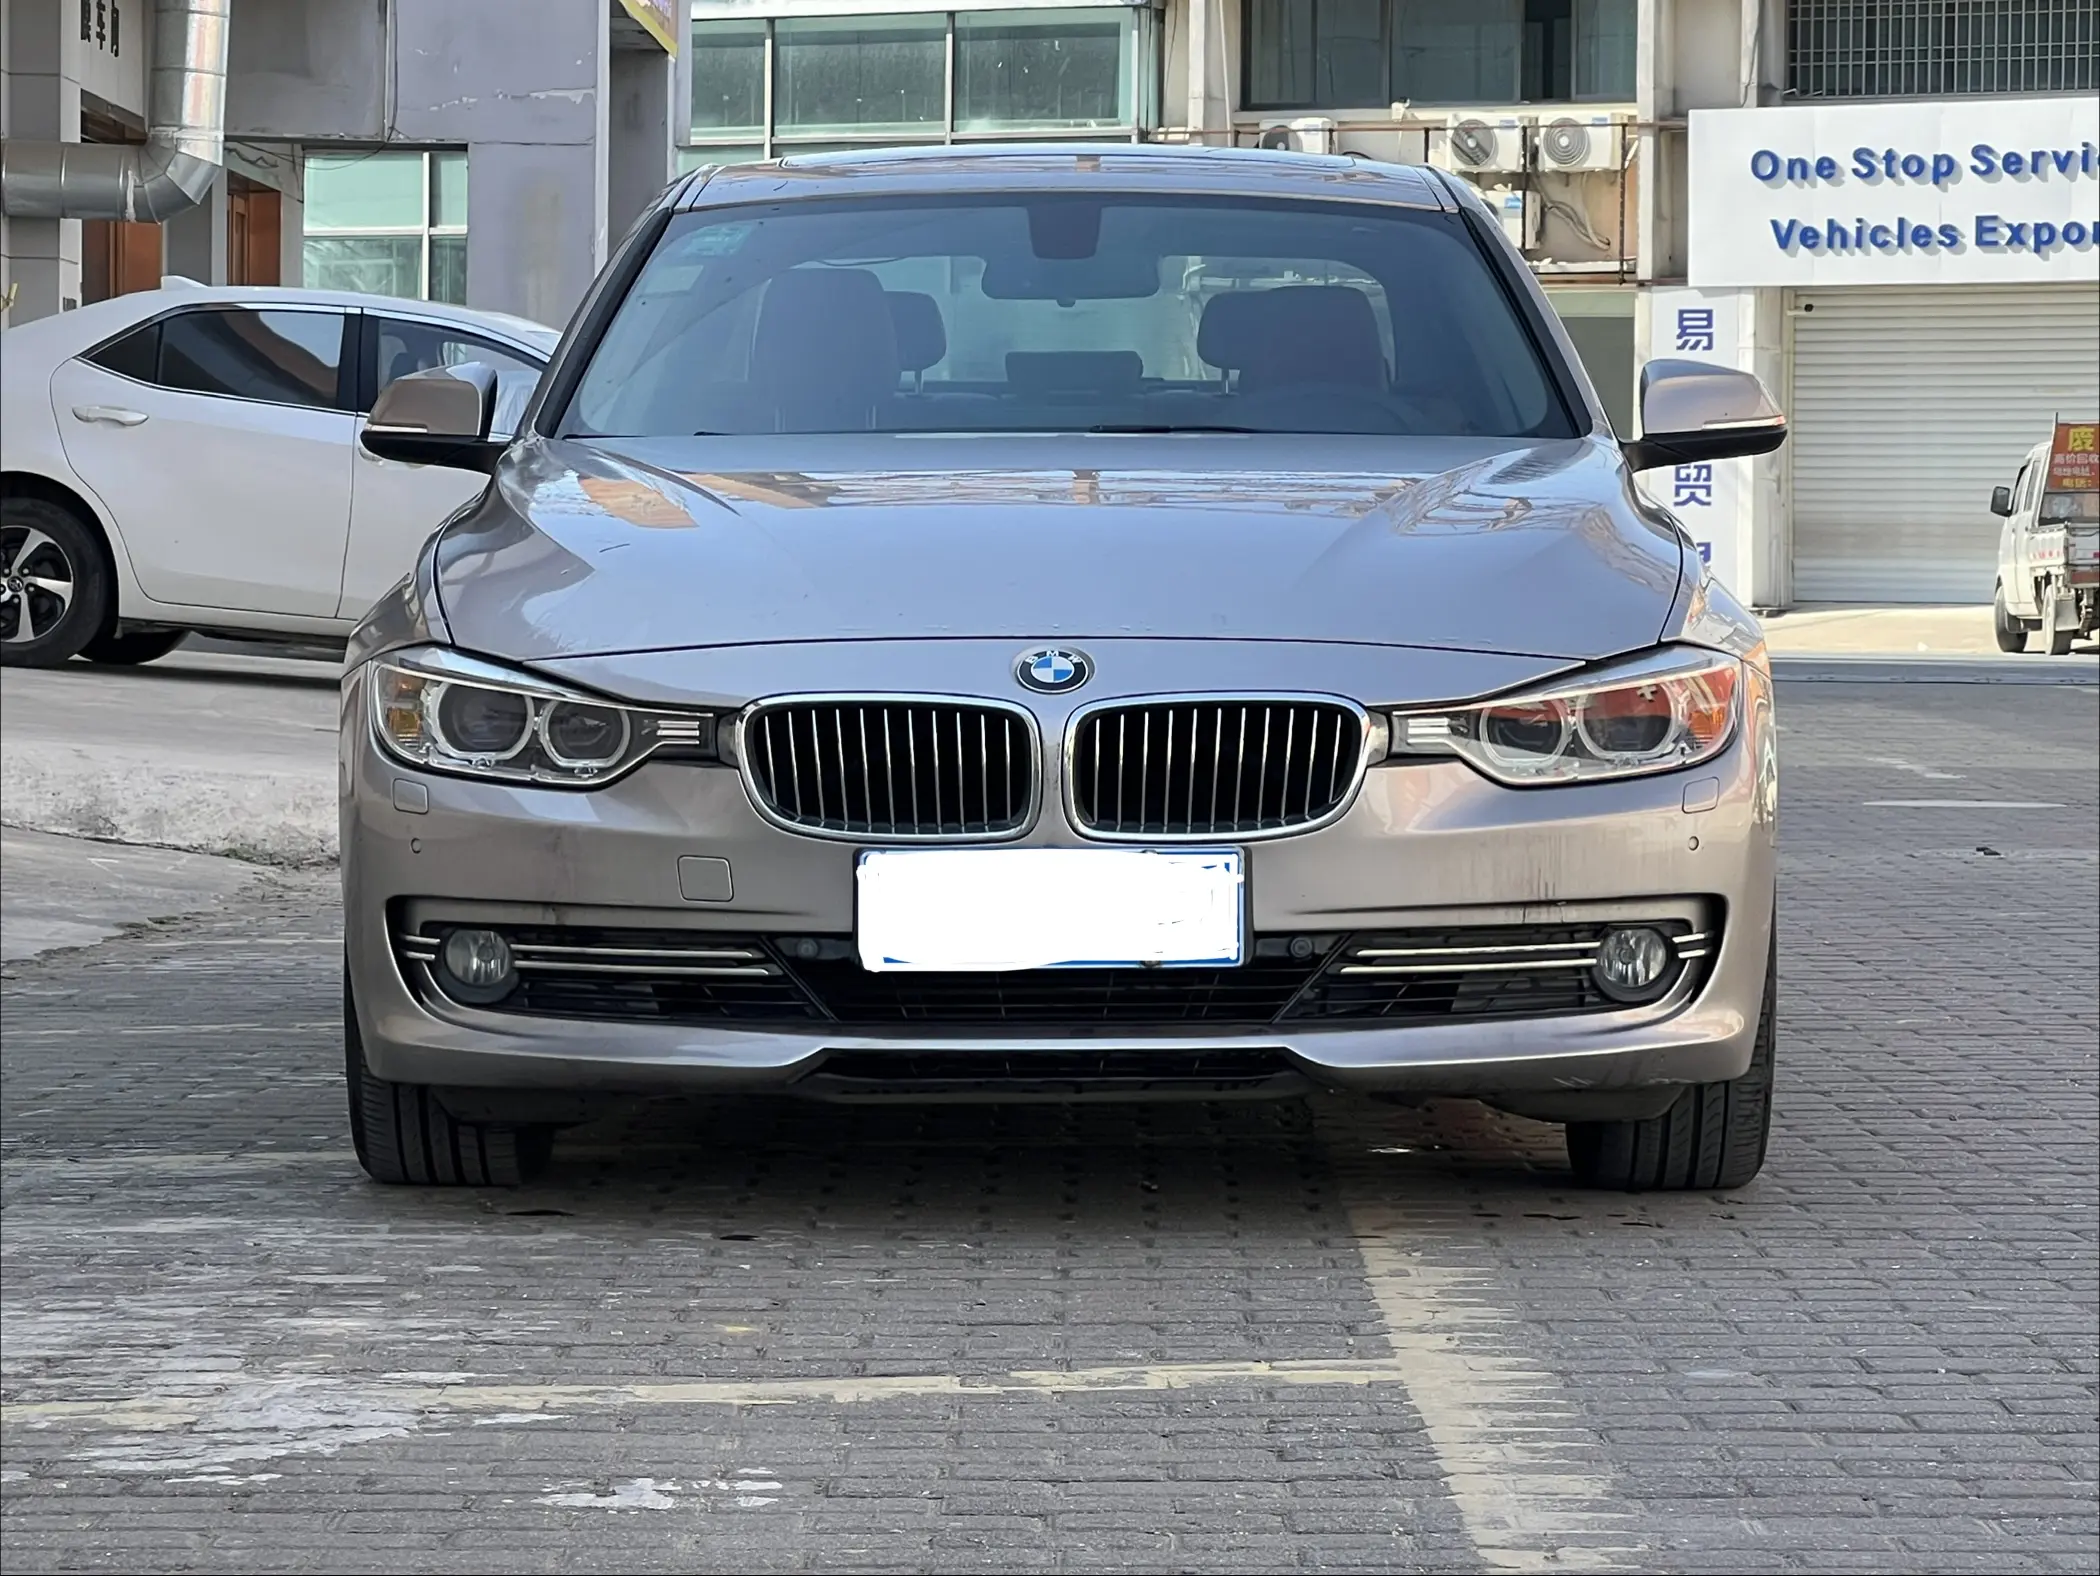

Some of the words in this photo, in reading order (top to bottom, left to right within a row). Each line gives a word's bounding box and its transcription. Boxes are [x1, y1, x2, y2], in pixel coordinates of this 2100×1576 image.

[1751, 150, 1836, 181] One
[1851, 147, 1955, 185] Stop
[1970, 143, 2099, 176] Servi
[1770, 217, 1958, 250] Vehicles
[1025, 651, 1082, 664] BMW
